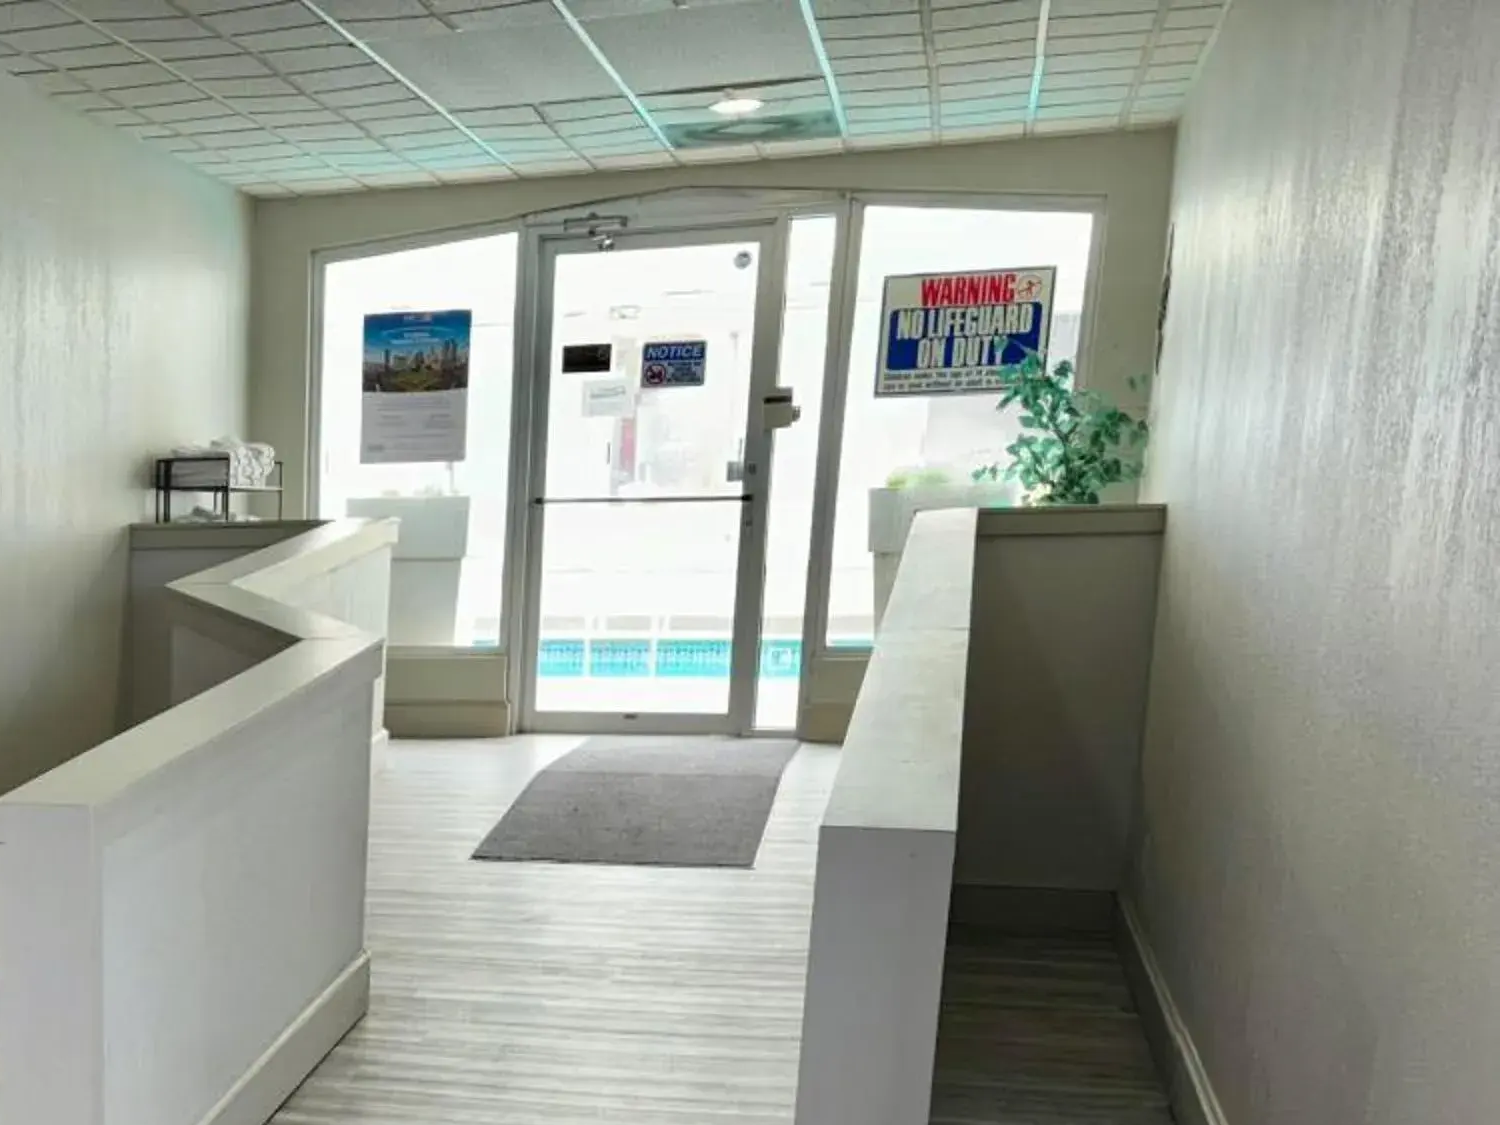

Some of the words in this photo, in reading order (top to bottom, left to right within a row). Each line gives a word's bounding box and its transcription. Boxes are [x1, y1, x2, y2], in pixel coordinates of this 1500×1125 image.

[921, 273, 1017, 307] WARNING
[896, 309, 924, 340] NO
[927, 304, 1034, 338] LIFEGUARD
[646, 346, 703, 360] NOTICE
[917, 337, 947, 369] ON
